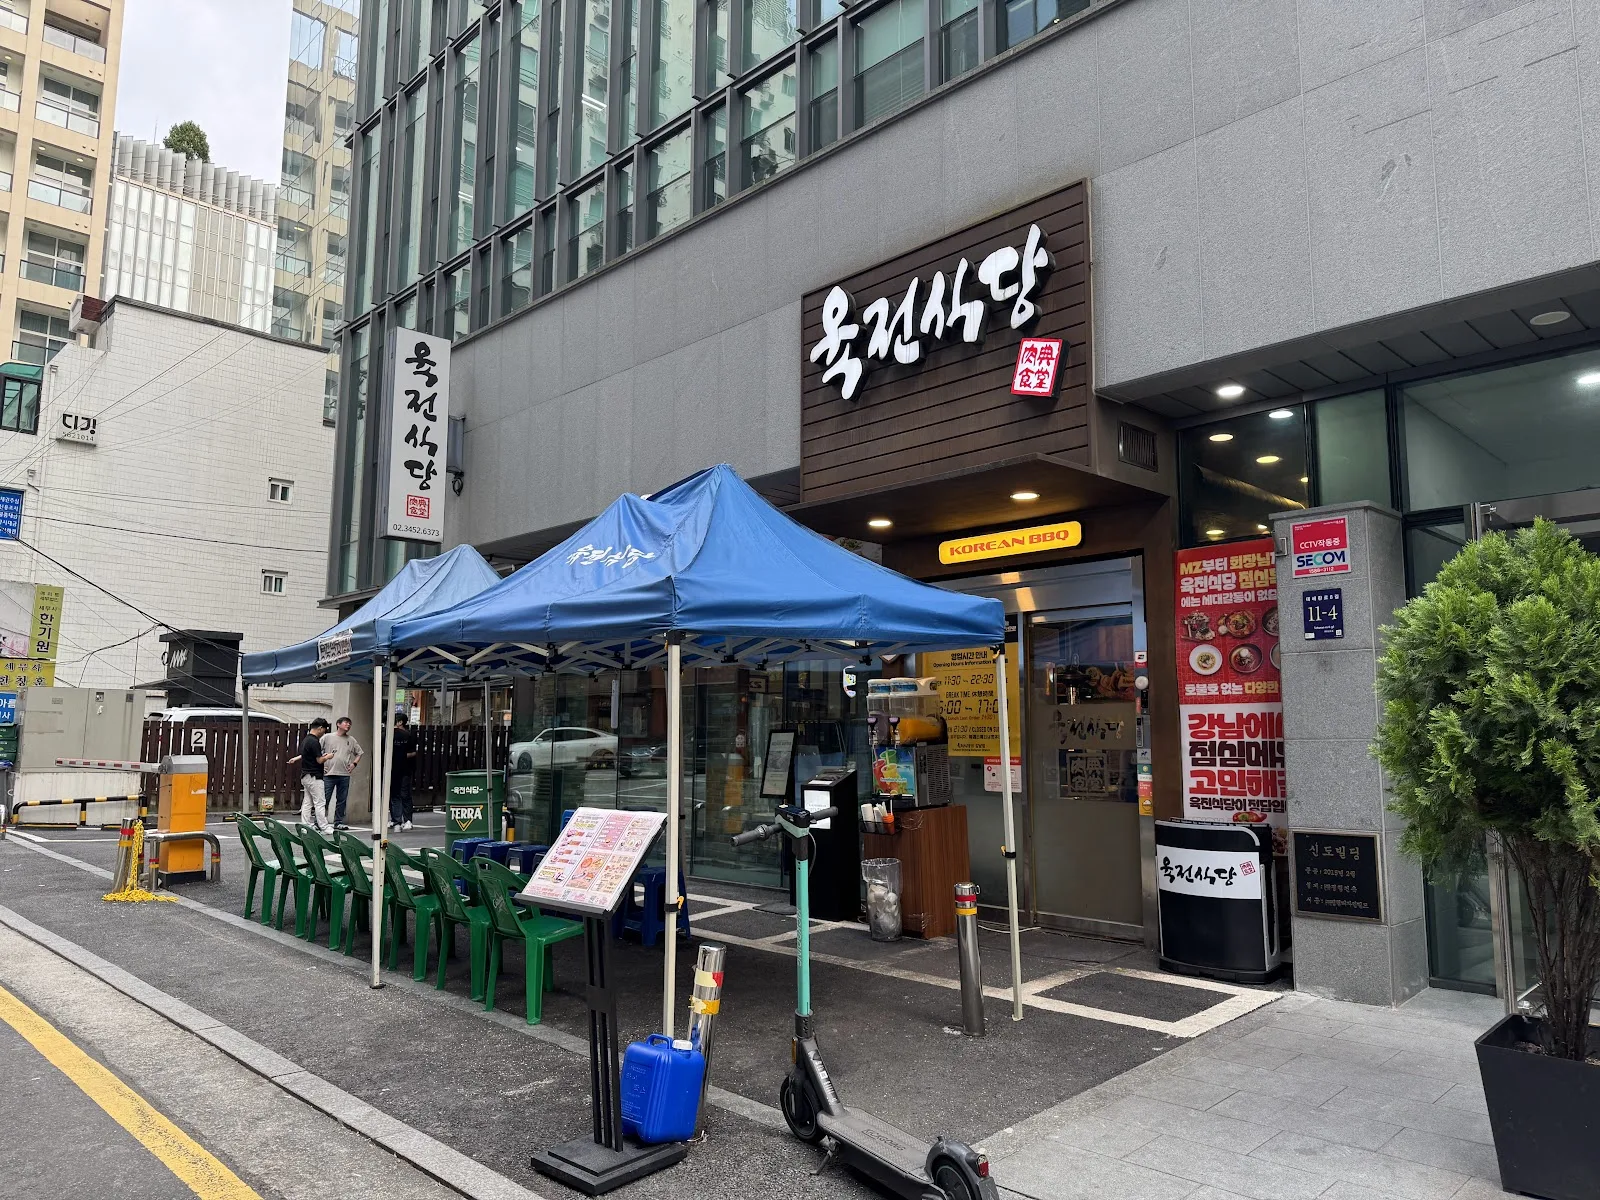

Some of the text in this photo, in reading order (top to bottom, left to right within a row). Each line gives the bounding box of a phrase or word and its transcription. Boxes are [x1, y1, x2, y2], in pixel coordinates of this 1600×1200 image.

[810, 224, 1051, 400] 육전식당
[404, 341, 438, 490] 육전식당
[392, 523, 440, 537] 02.3452.6373
[949, 529, 1070, 556] KOREAN BBQ
[1299, 537, 1340, 549] CCTV작동중
[1180, 551, 1275, 575] MZ부터 회장님
[1296, 550, 1346, 568] SECOM
[1180, 572, 1236, 594] 육전식당
[1181, 596, 1201, 608] 에는
[1201, 590, 1255, 606] 세대갈등이
[1307, 604, 1338, 622] 11-4
[36, 612, 55, 653] 한기원
[970, 673, 994, 685] 22:30
[1184, 680, 1279, 696] 호불호 없는 다양한
[1188, 712, 1284, 739] 강남에
[192, 731, 204, 745] 2
[459, 733, 467, 745] 4
[450, 807, 483, 820] TERRA
[1247, 799, 1287, 814] 정답입
[1308, 841, 1360, 861] 신도빌딩
[1160, 856, 1237, 886] 육전식당
